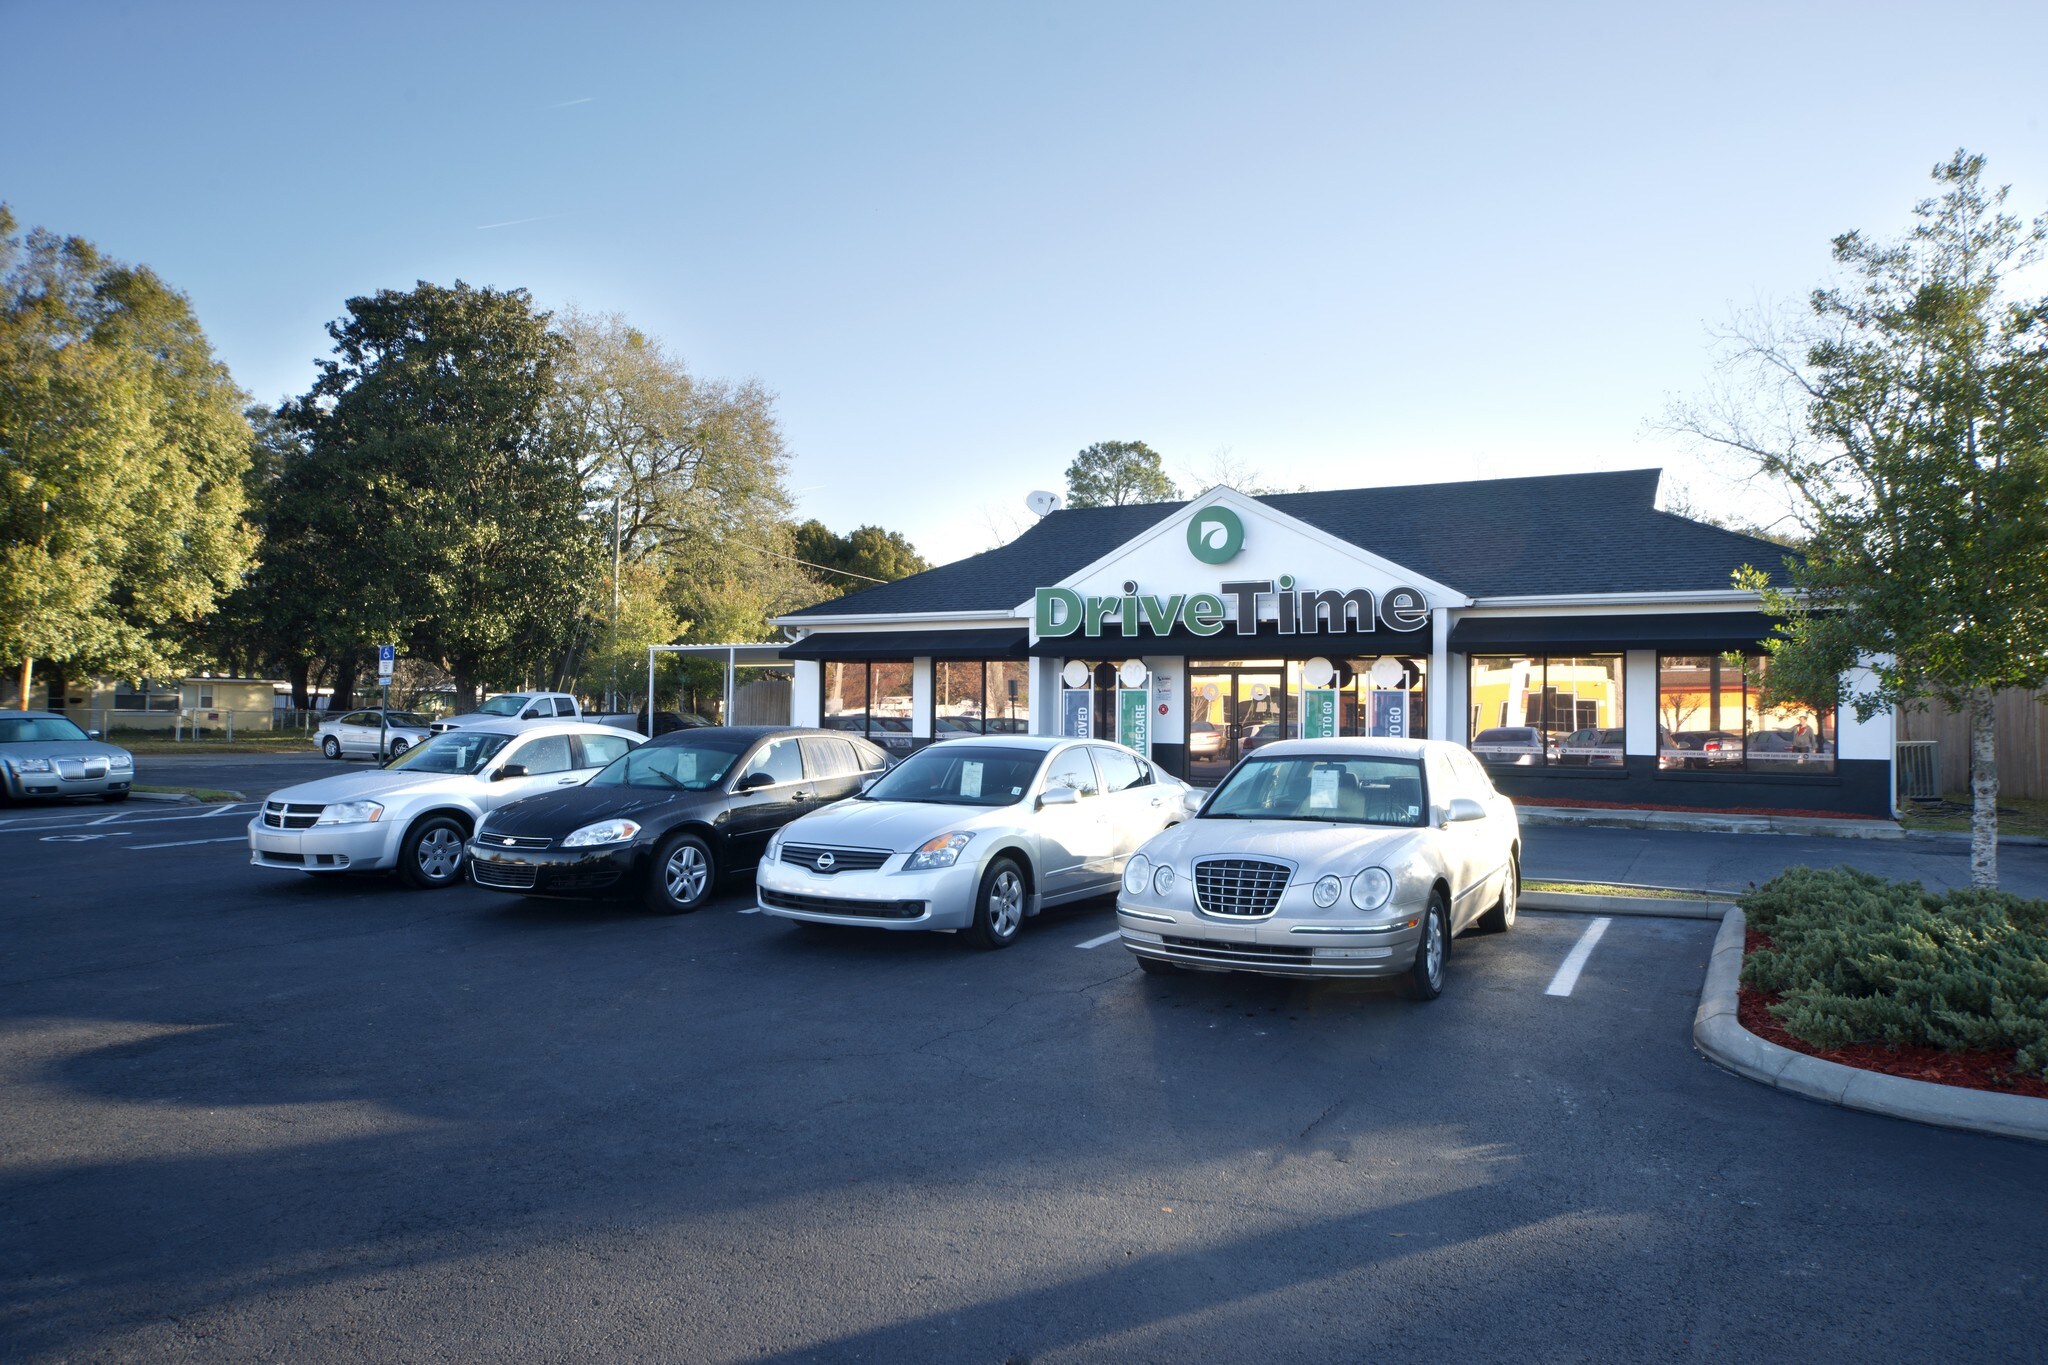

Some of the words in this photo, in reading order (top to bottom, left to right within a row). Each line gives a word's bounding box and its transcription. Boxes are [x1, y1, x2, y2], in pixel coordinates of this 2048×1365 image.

[1034, 573, 1429, 638] DriveTime
[1323, 701, 1332, 715] GO
[1389, 707, 1401, 723] GO
[1323, 716, 1332, 729] TO
